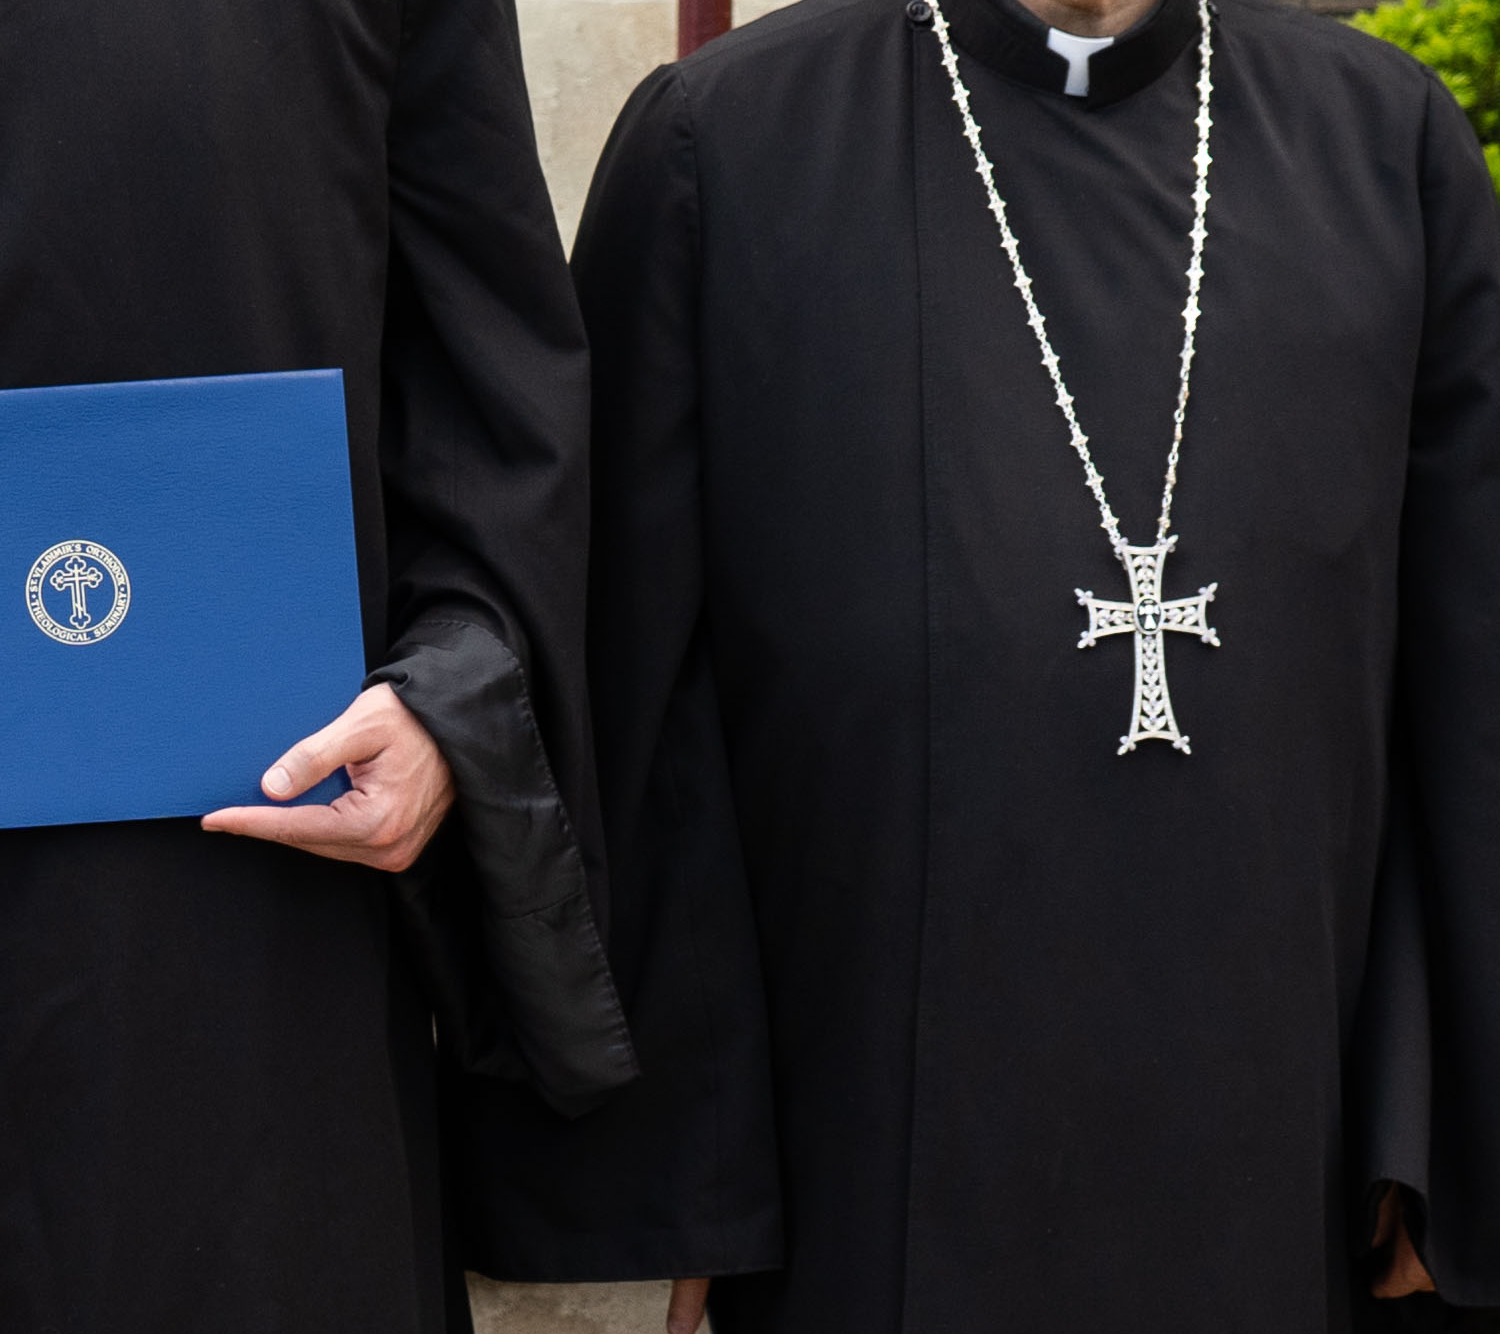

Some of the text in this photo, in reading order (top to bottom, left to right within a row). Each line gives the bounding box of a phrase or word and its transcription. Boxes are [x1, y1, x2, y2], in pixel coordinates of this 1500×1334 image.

[33, 544, 82, 578] VLADIMIR'S
[86, 546, 126, 586] ORTHODOX
[31, 592, 127, 641] THEOLOGICAL SEMINARY
